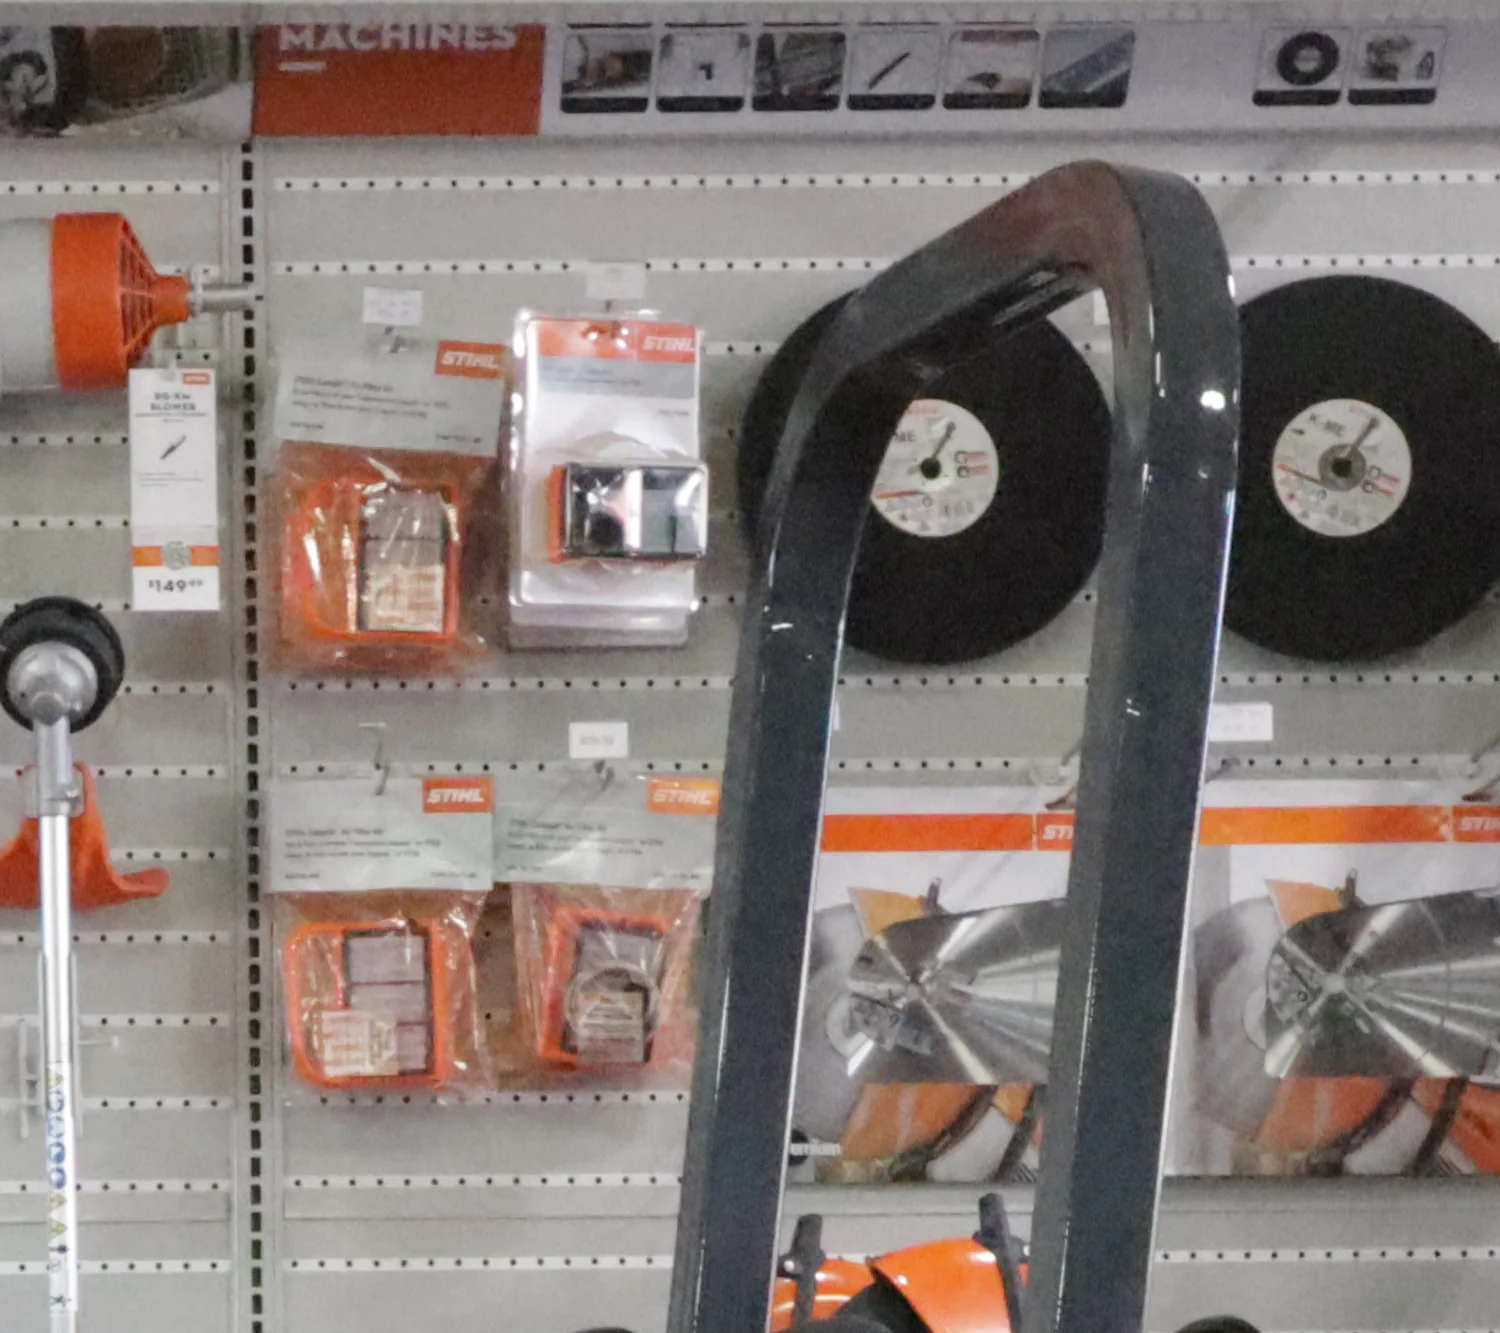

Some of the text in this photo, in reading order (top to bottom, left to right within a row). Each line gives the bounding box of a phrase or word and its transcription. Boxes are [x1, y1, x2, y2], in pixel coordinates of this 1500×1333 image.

[642, 333, 697, 352] STIHL
[440, 351, 500, 370] STIHL
[426, 788, 485, 805] STIHL
[652, 789, 713, 806] STIHL
